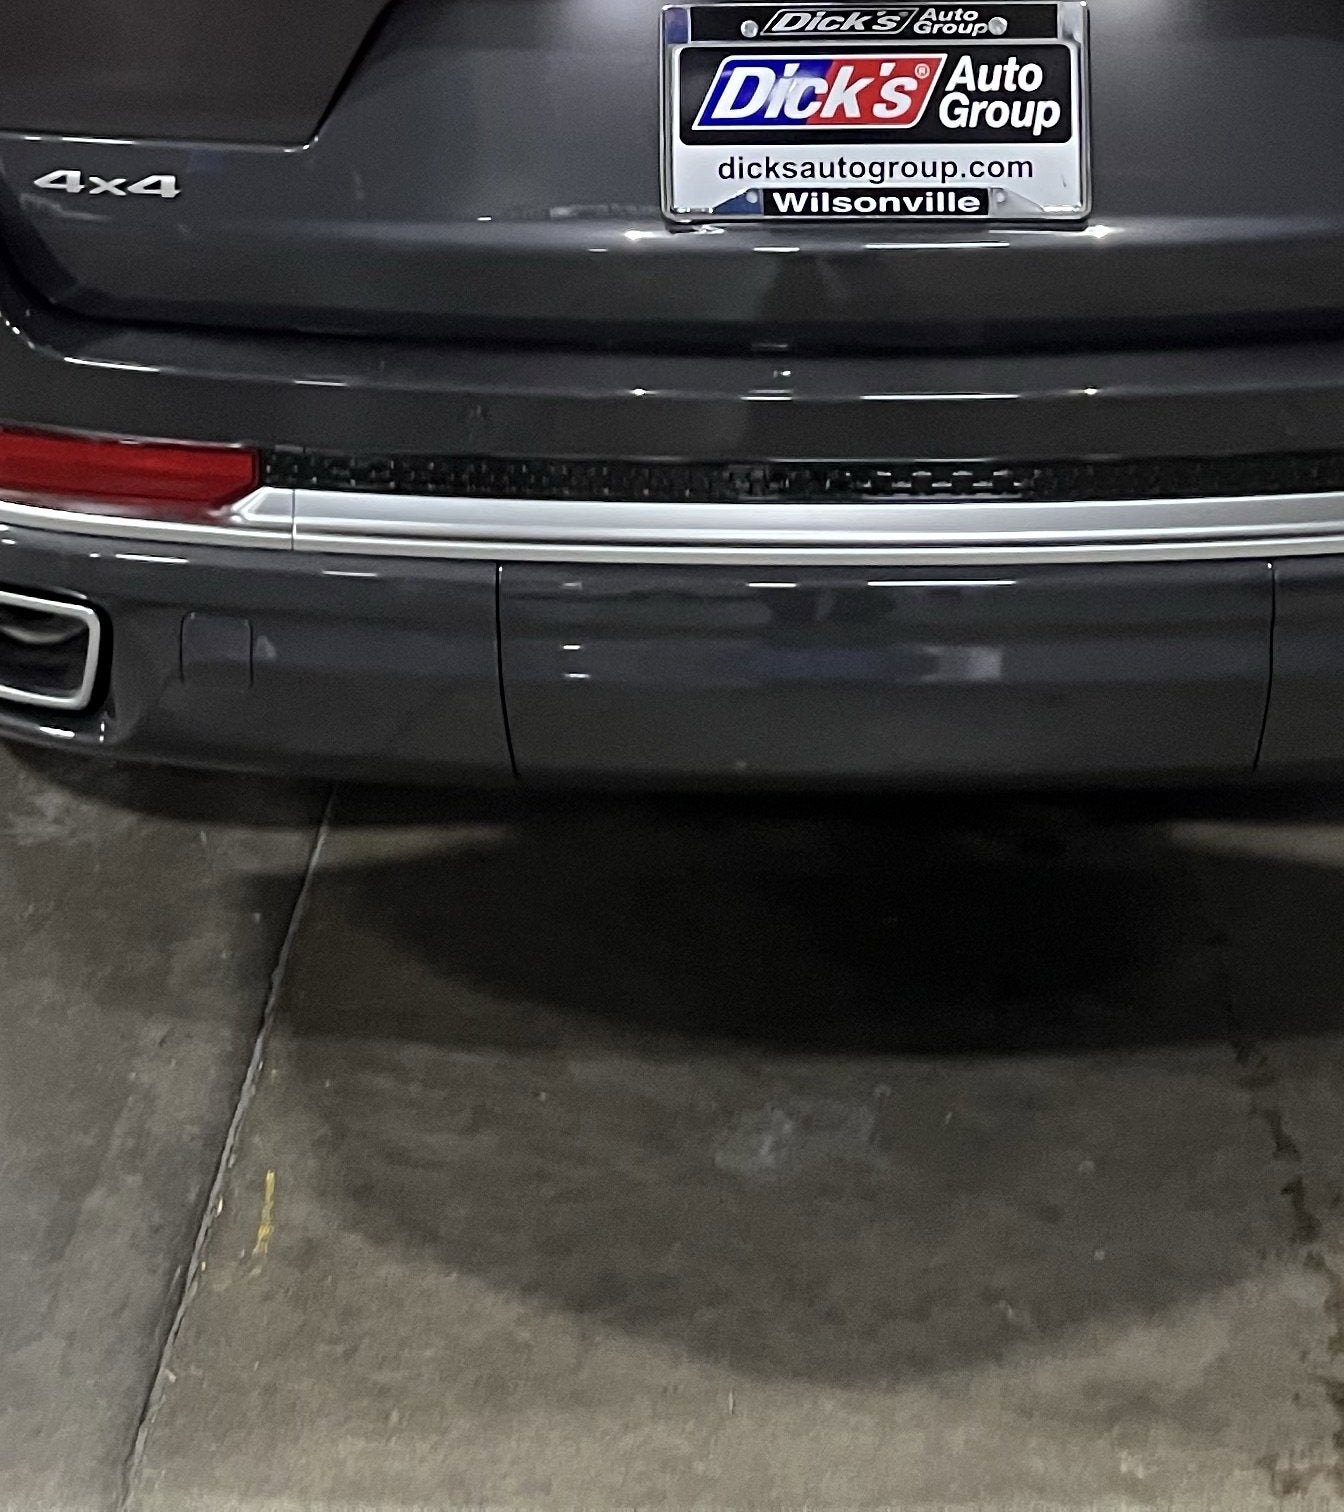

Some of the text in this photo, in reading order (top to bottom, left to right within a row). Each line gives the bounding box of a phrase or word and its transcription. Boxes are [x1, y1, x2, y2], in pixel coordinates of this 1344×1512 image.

[771, 10, 903, 33] Dick's
[913, 20, 988, 36] Group
[917, 8, 979, 22] Auto
[945, 55, 1044, 93] Auto
[711, 61, 917, 120] Dick's
[938, 92, 1061, 136] Group
[33, 169, 181, 199] 4x4
[718, 156, 1034, 184] dicksautogroup.com
[773, 191, 982, 214] Wilsonville
